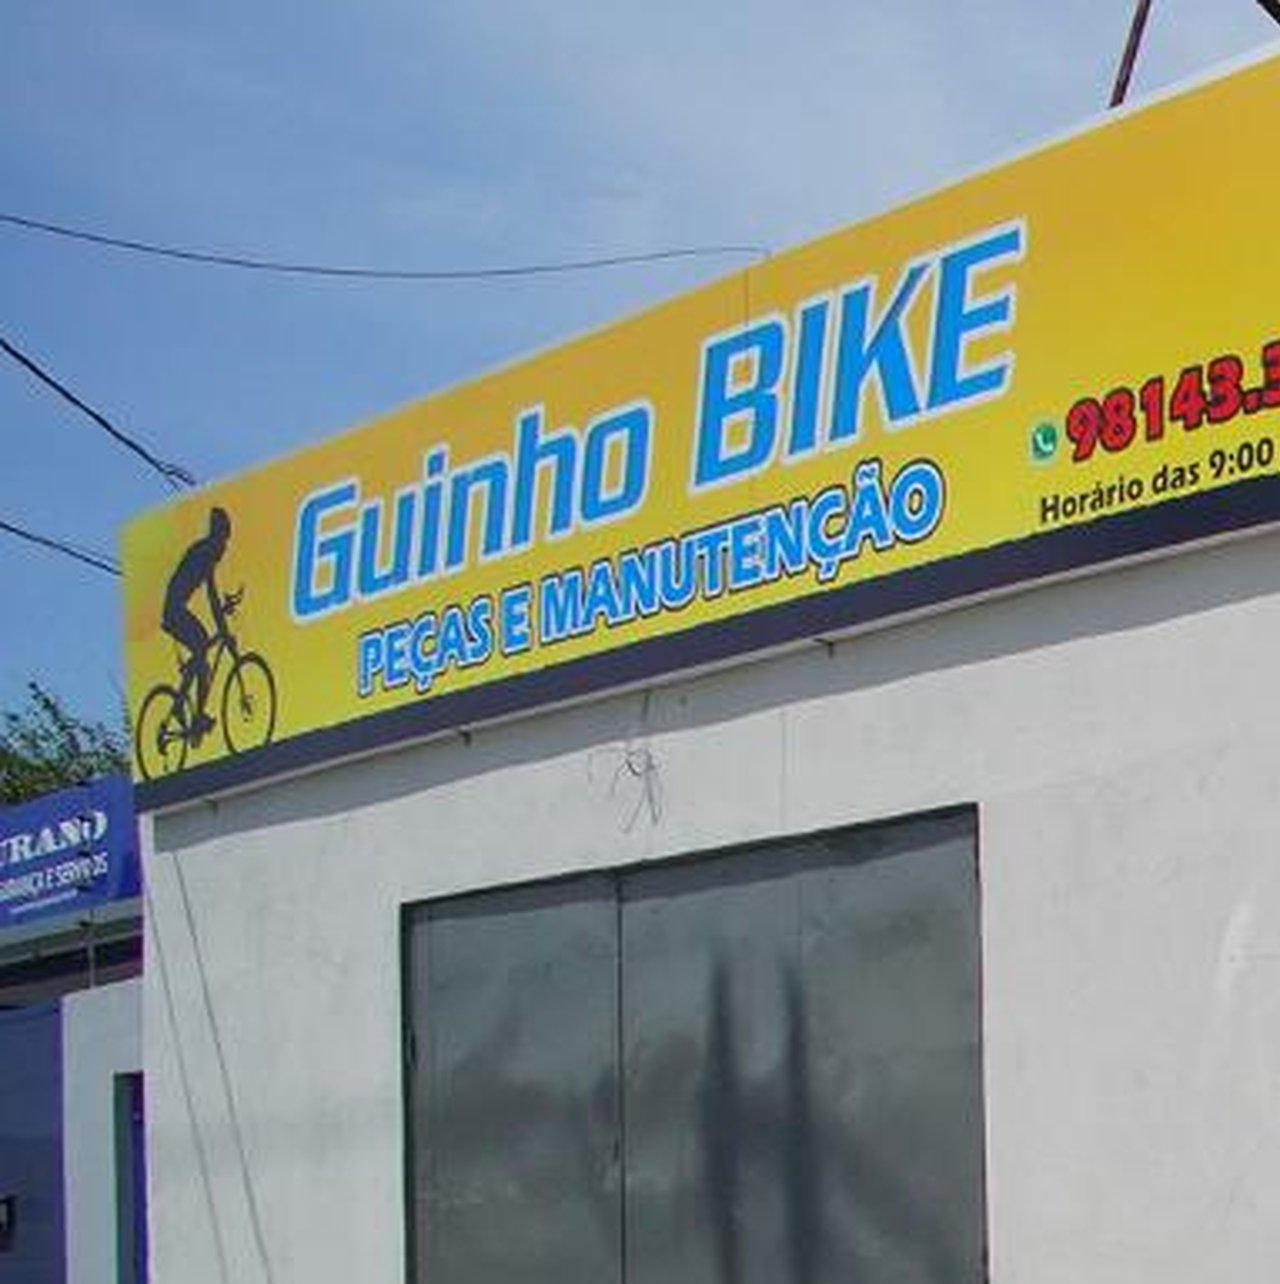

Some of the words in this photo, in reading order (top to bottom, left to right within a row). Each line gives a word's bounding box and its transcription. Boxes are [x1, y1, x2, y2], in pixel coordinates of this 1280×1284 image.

[291, 403, 654, 622] Guinho
[689, 220, 1026, 495] BIKE
[1040, 476, 1144, 524] Horário
[1151, 464, 1201, 495] das
[1208, 437, 1275, 480] 9:00
[357, 592, 496, 696] PEÇAS
[499, 583, 535, 656] E
[540, 459, 946, 646] MANUTENÇÃO
